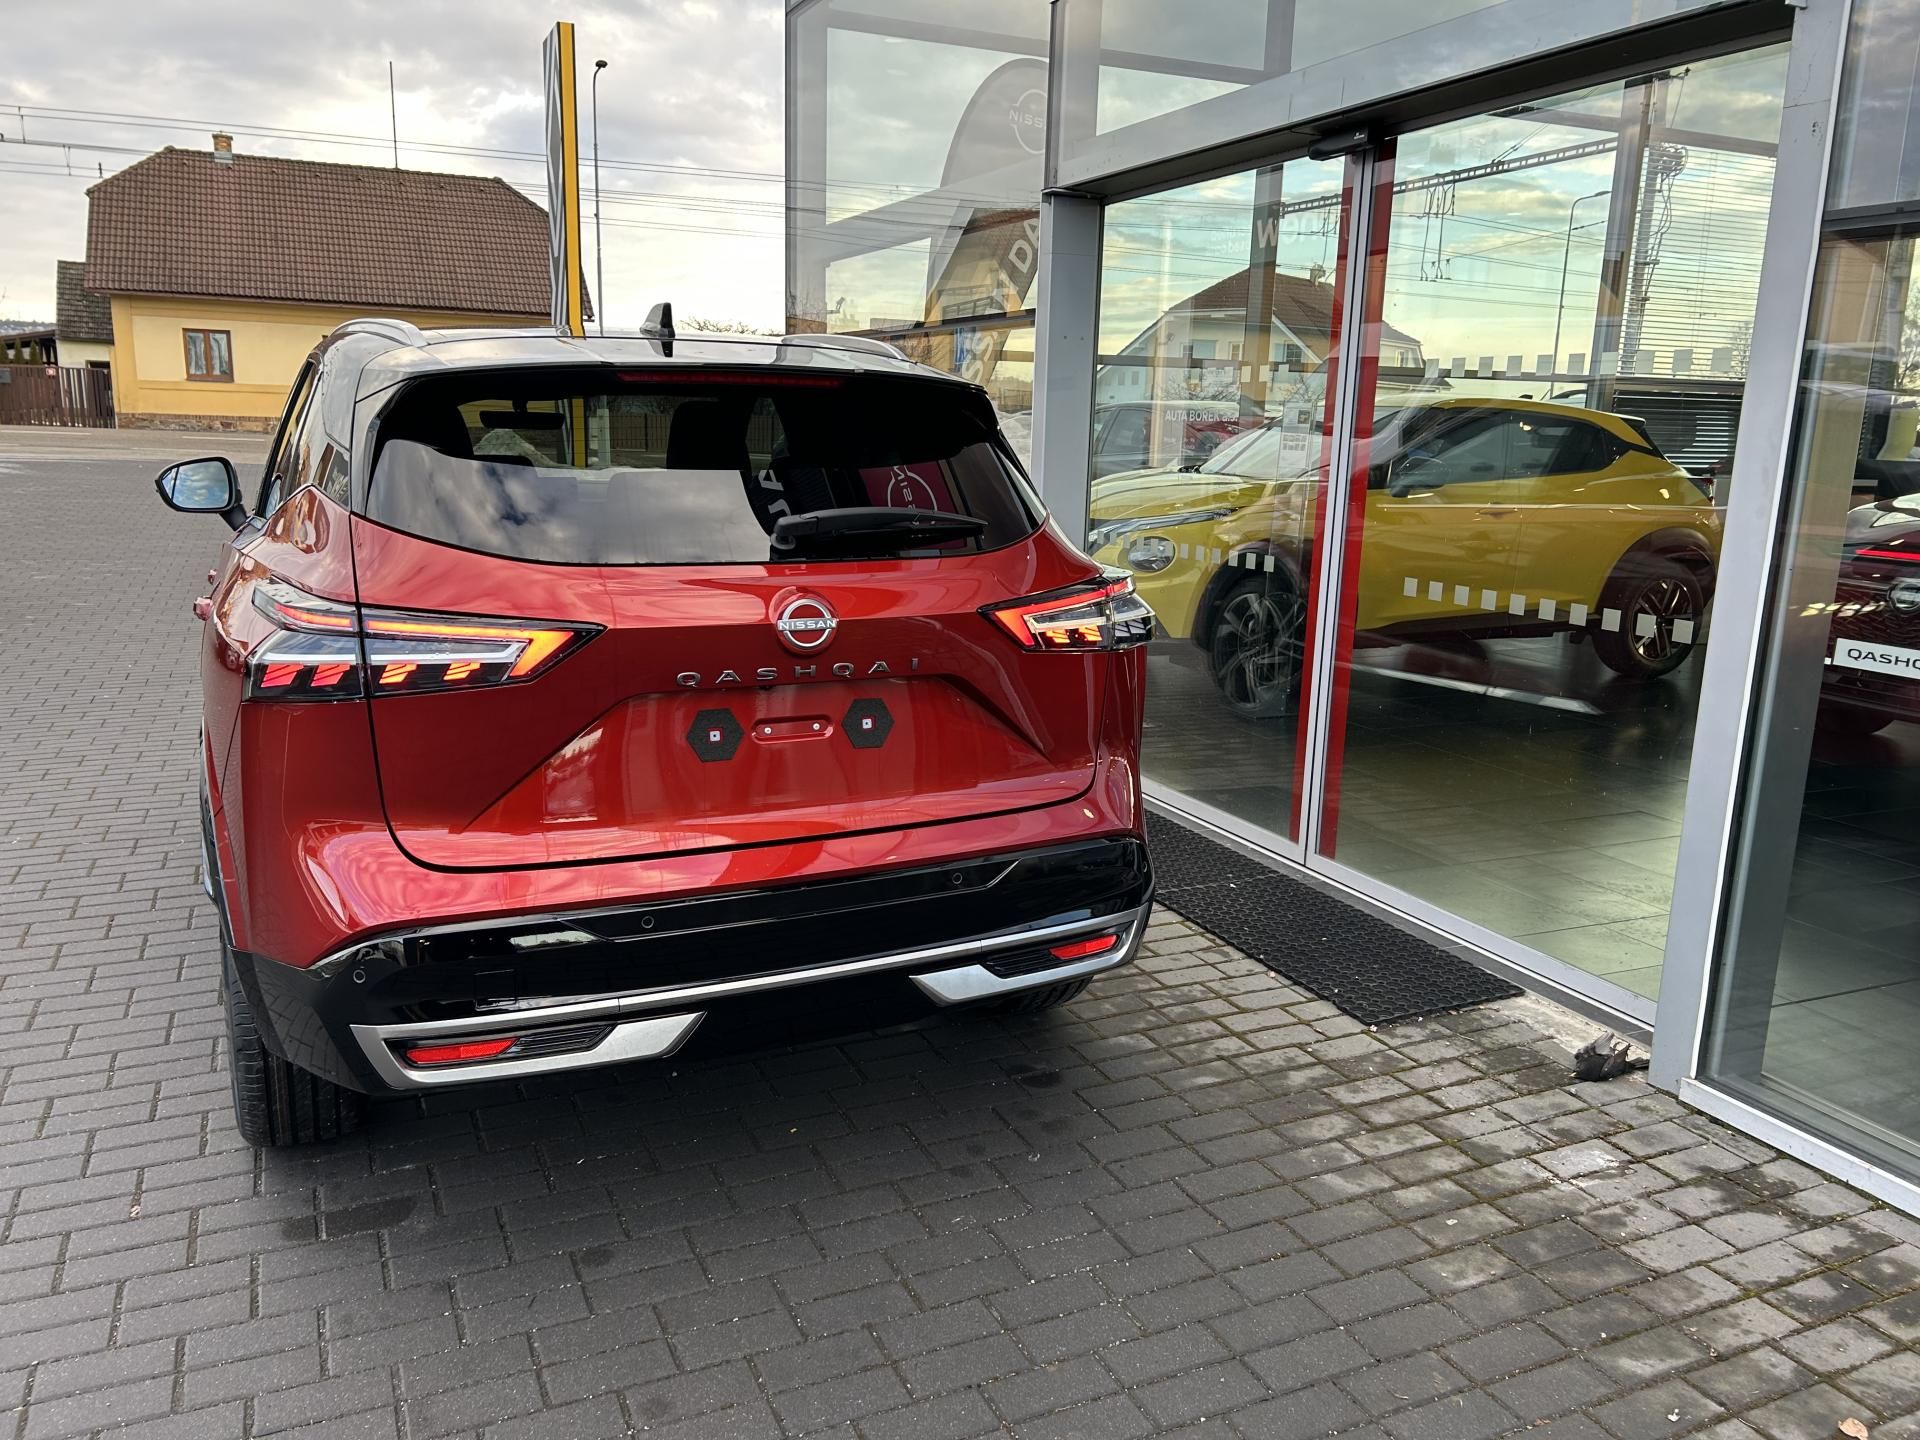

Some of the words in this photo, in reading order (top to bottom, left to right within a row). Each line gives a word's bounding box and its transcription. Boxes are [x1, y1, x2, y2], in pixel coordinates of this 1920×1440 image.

[1165, 409, 1187, 422] AUTA
[778, 618, 836, 631] NISSAN
[676, 657, 919, 688] QASHQAI
